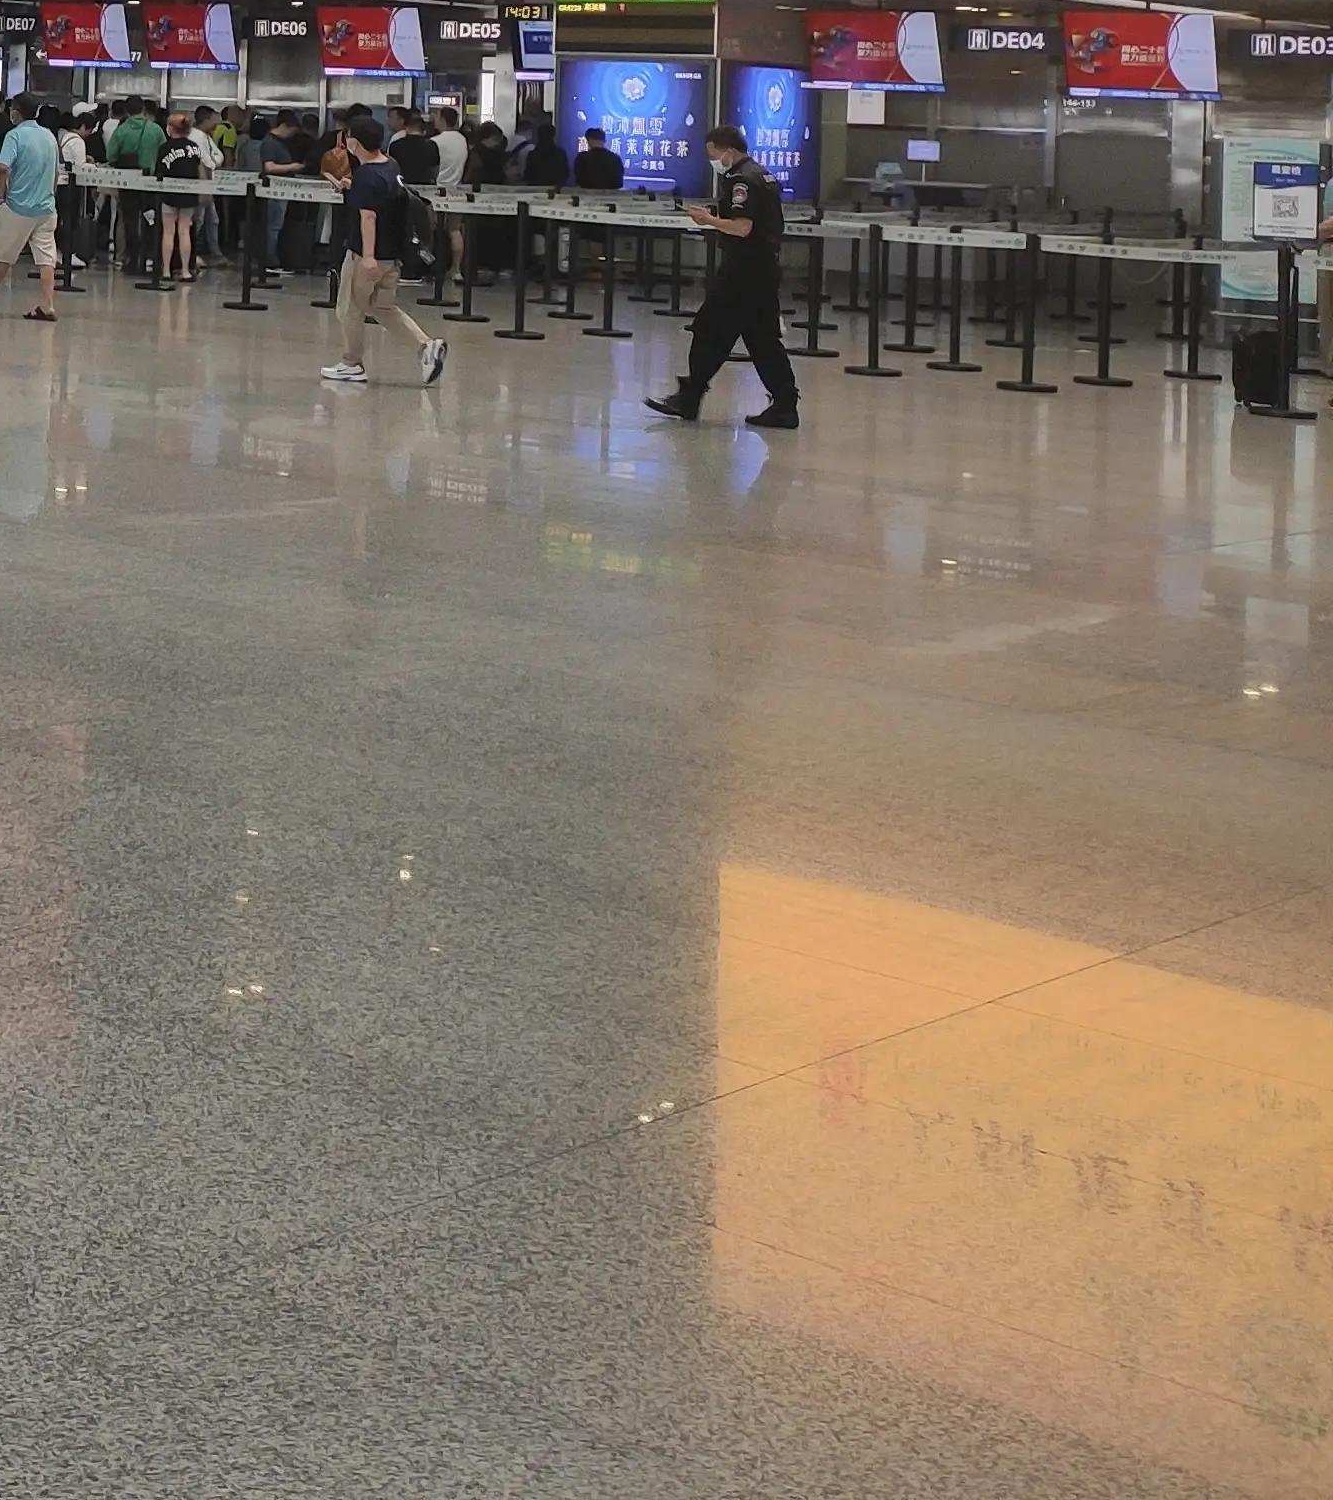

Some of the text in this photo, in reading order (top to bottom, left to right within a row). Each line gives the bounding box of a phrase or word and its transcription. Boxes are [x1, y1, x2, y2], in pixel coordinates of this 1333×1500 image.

[504, 6, 540, 19] 14:03
[6, 17, 36, 31] DE07
[271, 21, 307, 37] DE06
[459, 22, 502, 39] DE05
[992, 32, 1045, 50] DE04
